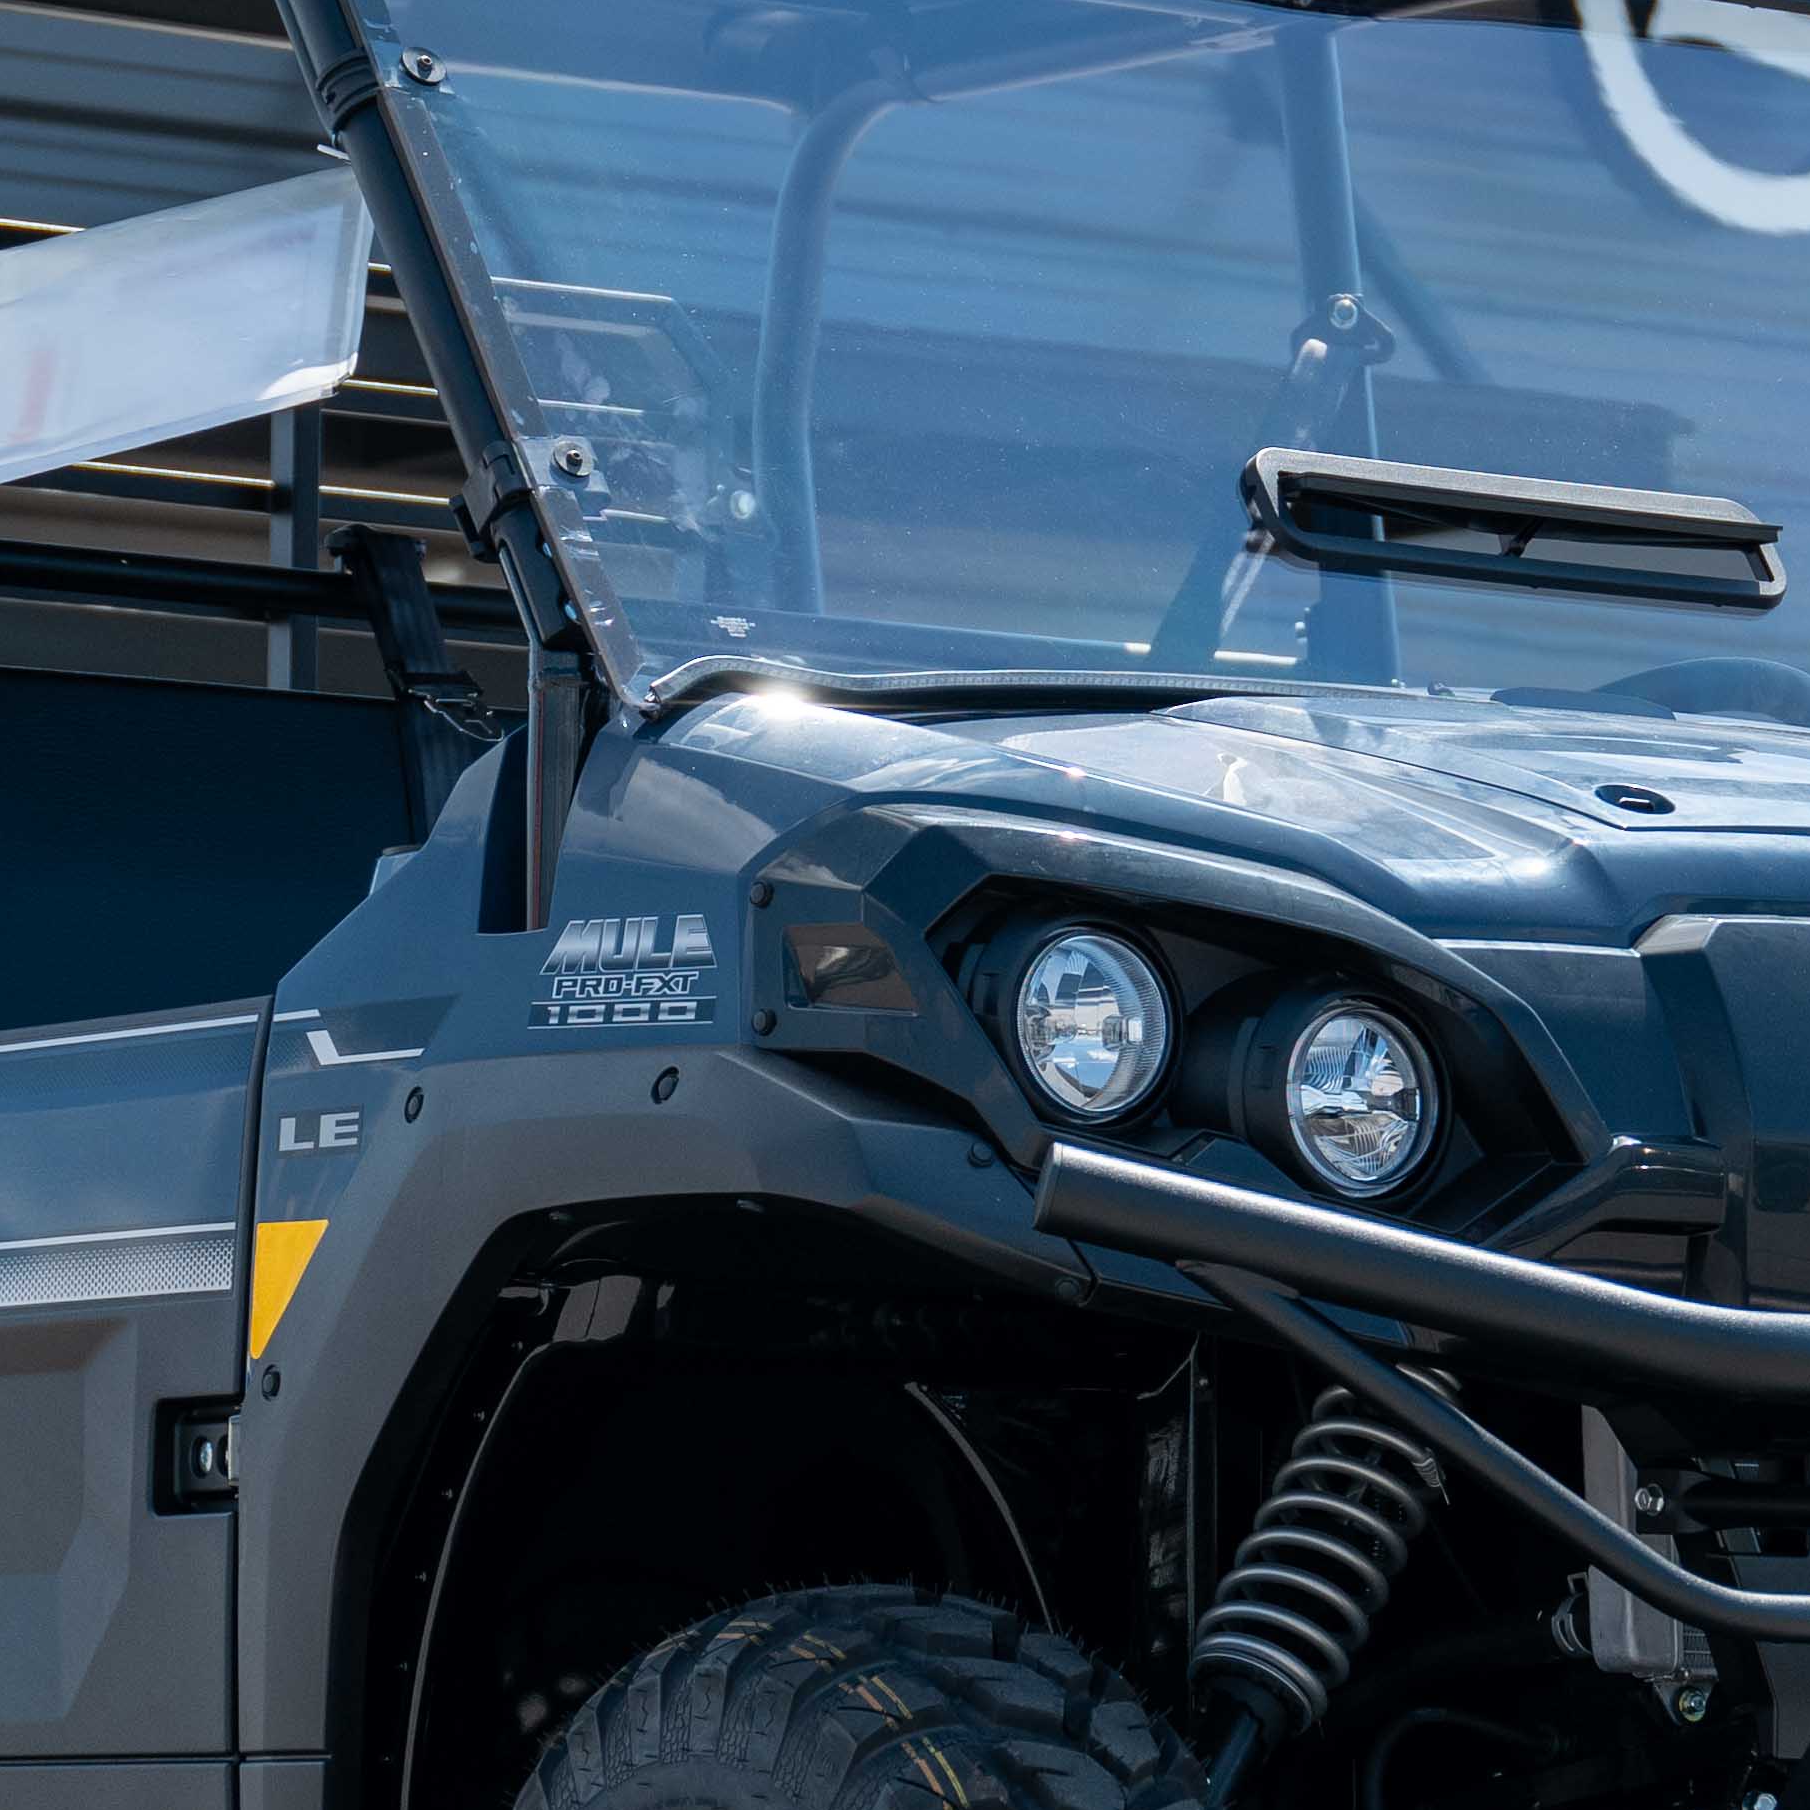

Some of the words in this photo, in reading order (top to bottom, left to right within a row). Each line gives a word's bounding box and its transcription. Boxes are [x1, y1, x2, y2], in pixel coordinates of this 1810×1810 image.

[539, 913, 718, 976] MULE
[551, 971, 700, 999] PRO-FXT
[547, 1001, 698, 1025] 1000
[278, 1111, 361, 1153] LE
